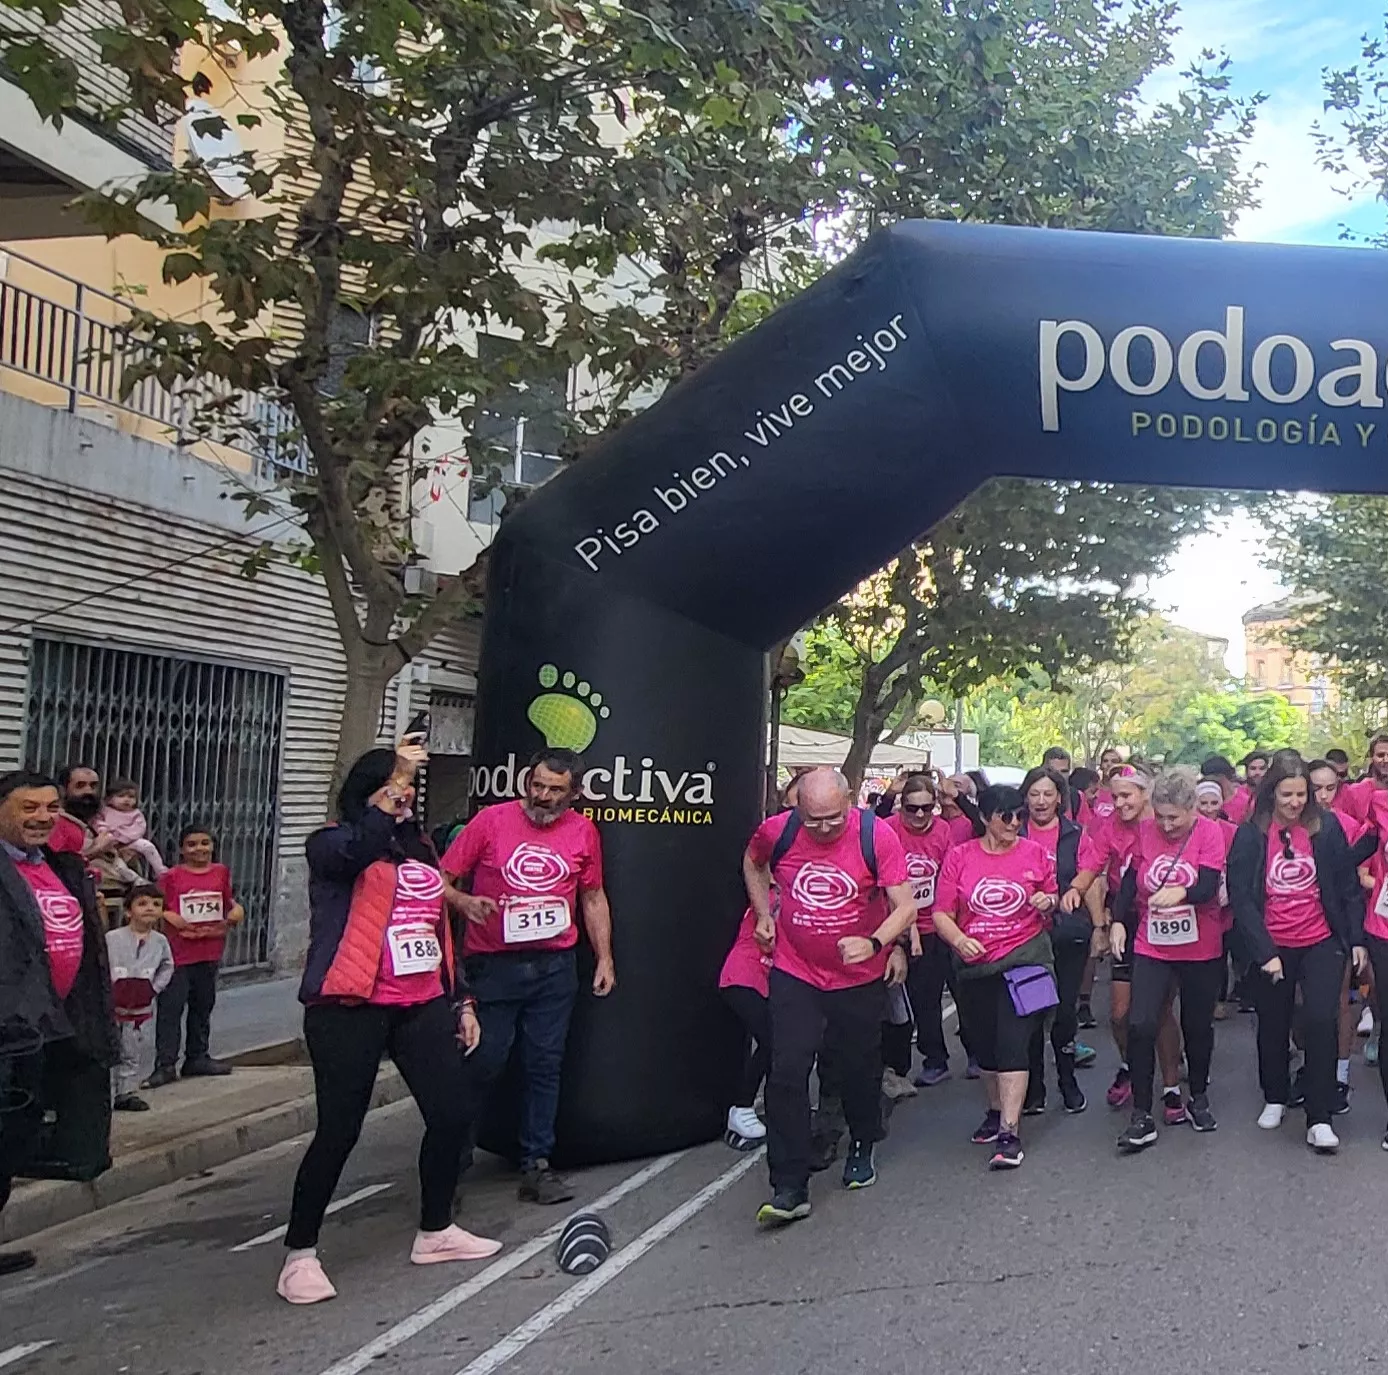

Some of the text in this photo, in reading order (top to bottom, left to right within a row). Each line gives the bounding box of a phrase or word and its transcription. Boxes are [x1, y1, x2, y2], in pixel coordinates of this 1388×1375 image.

[1131, 412, 1341, 447] PODOLOGÍA
[1356, 426, 1374, 447] Y
[574, 313, 909, 571] Pisa bien, vive mejor
[583, 805, 712, 825] BIOMECÁNICA
[913, 888, 930, 900] 40
[187, 902, 220, 914] 1754
[518, 910, 556, 929] 315
[1151, 919, 1191, 935] 1890
